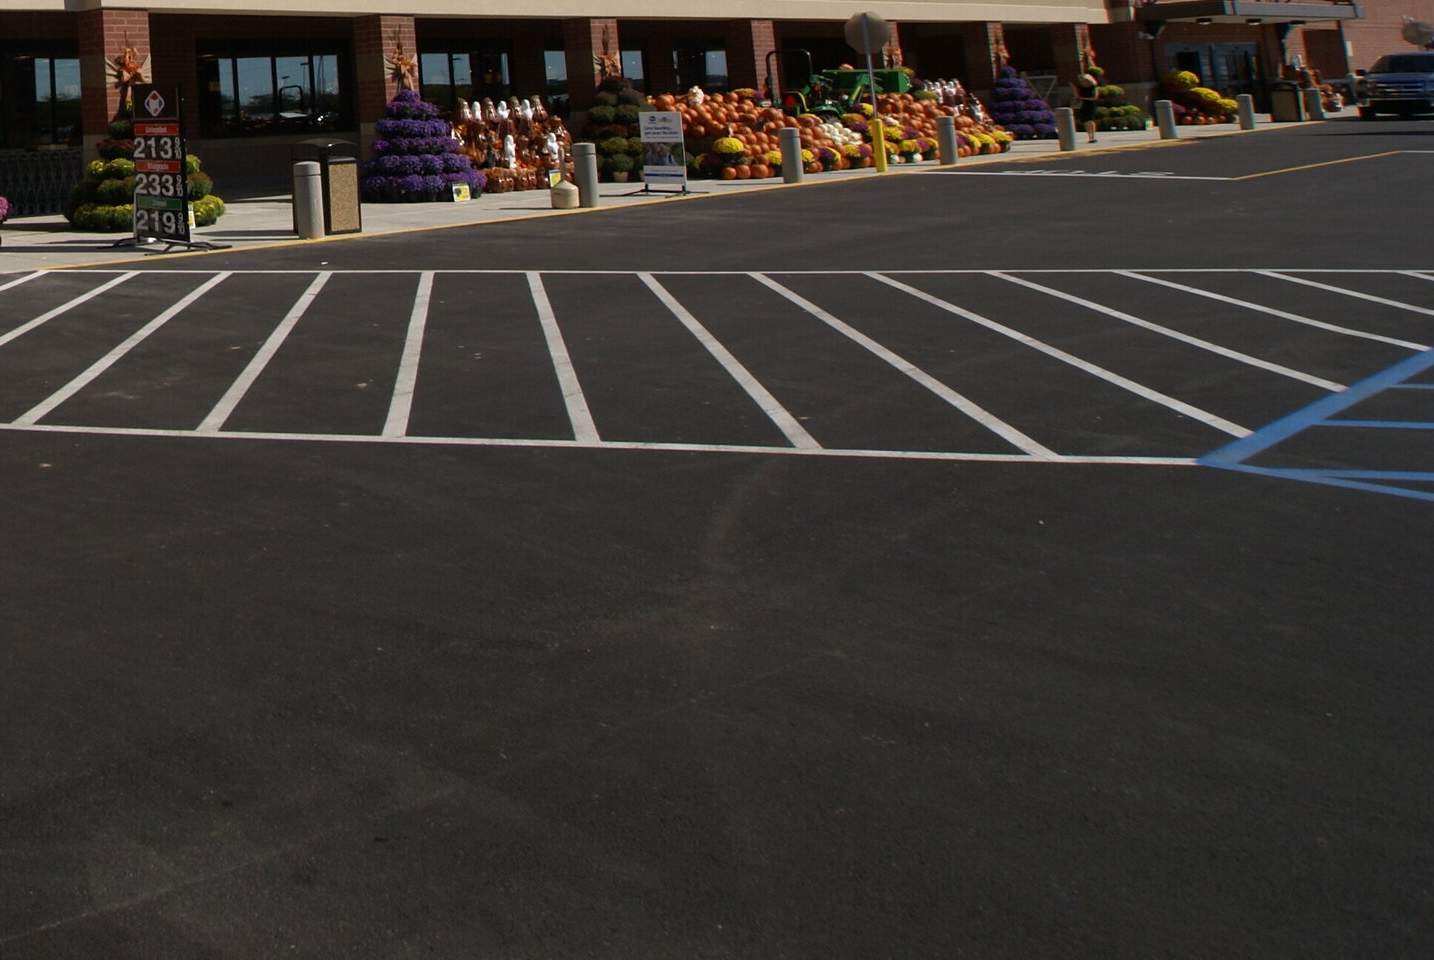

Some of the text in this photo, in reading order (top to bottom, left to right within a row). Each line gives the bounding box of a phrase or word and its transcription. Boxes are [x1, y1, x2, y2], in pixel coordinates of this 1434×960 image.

[133, 137, 172, 159] 213
[135, 173, 175, 196] 233
[136, 209, 176, 234] 219
